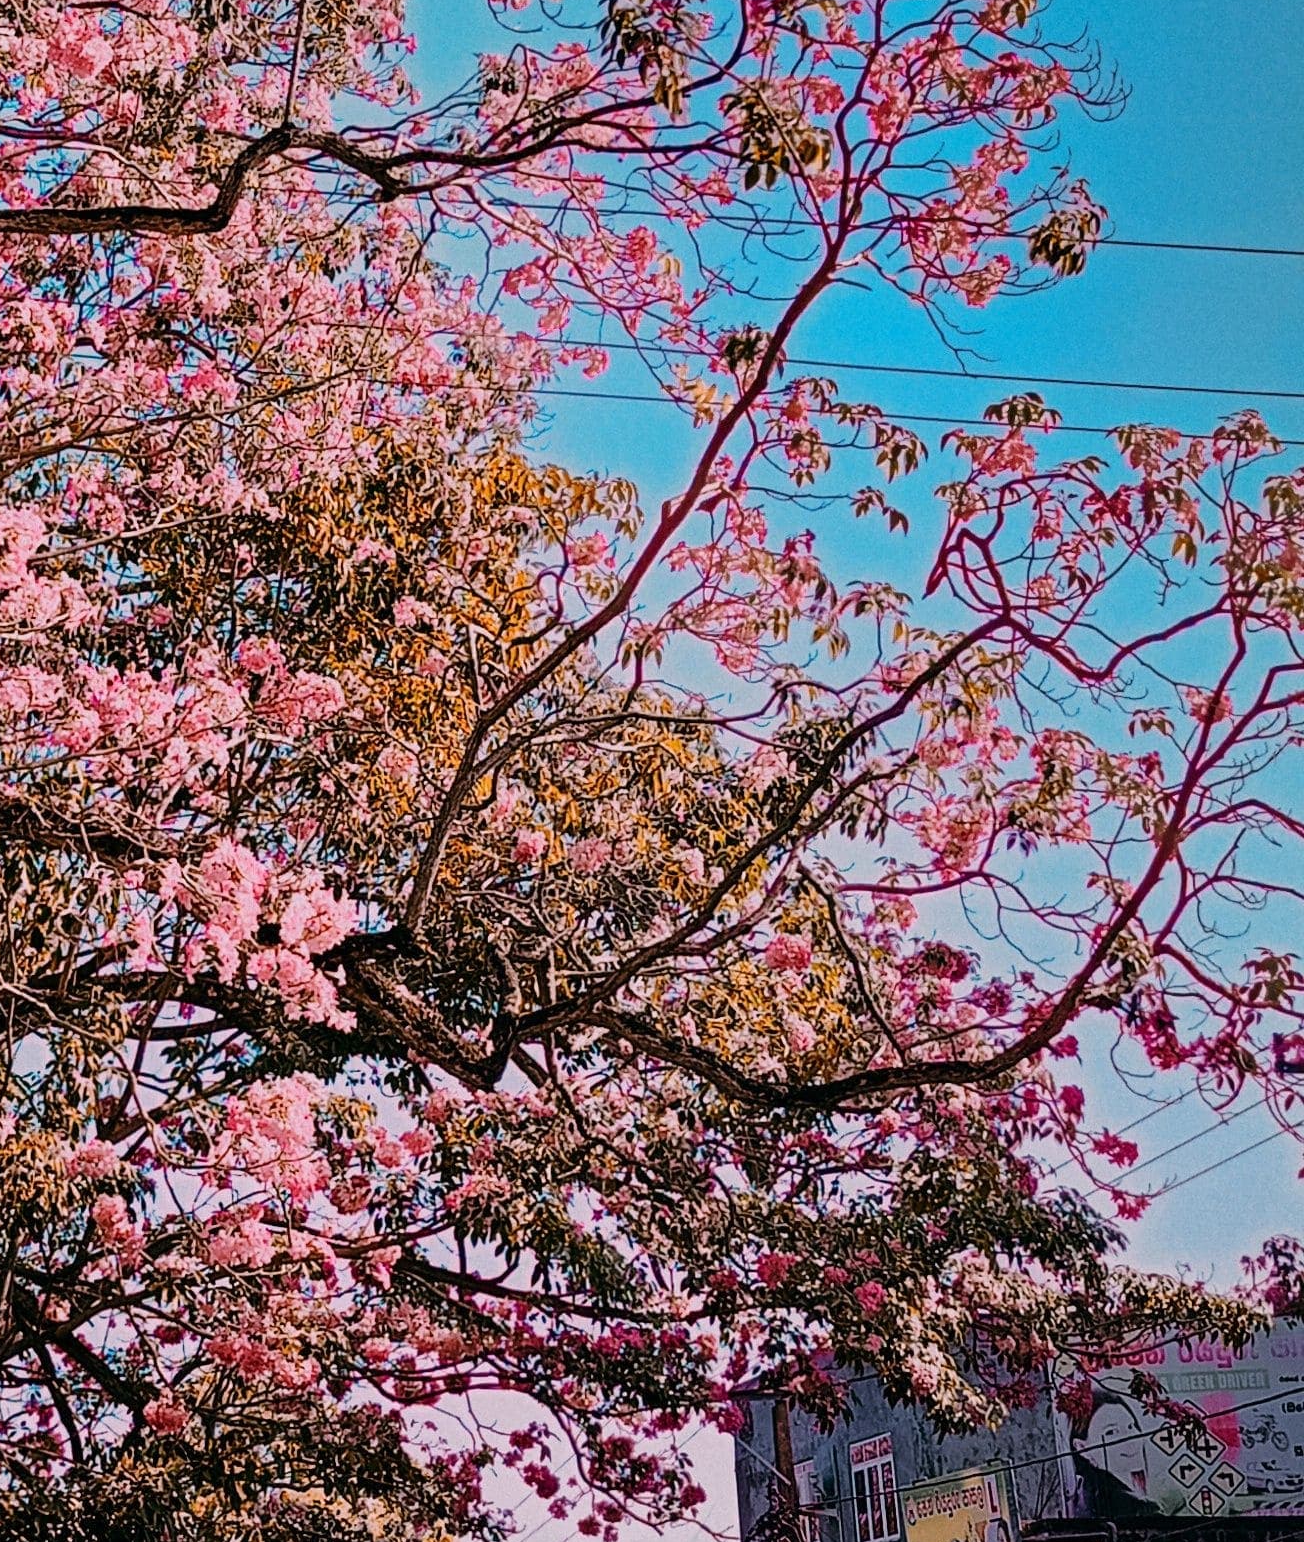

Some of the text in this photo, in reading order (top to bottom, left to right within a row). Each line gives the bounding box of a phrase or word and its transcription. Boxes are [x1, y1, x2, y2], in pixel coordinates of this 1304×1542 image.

[1173, 1374, 1215, 1390] GREEN
[1218, 1373, 1264, 1388] DRIVER
[988, 1481, 998, 1513] L
